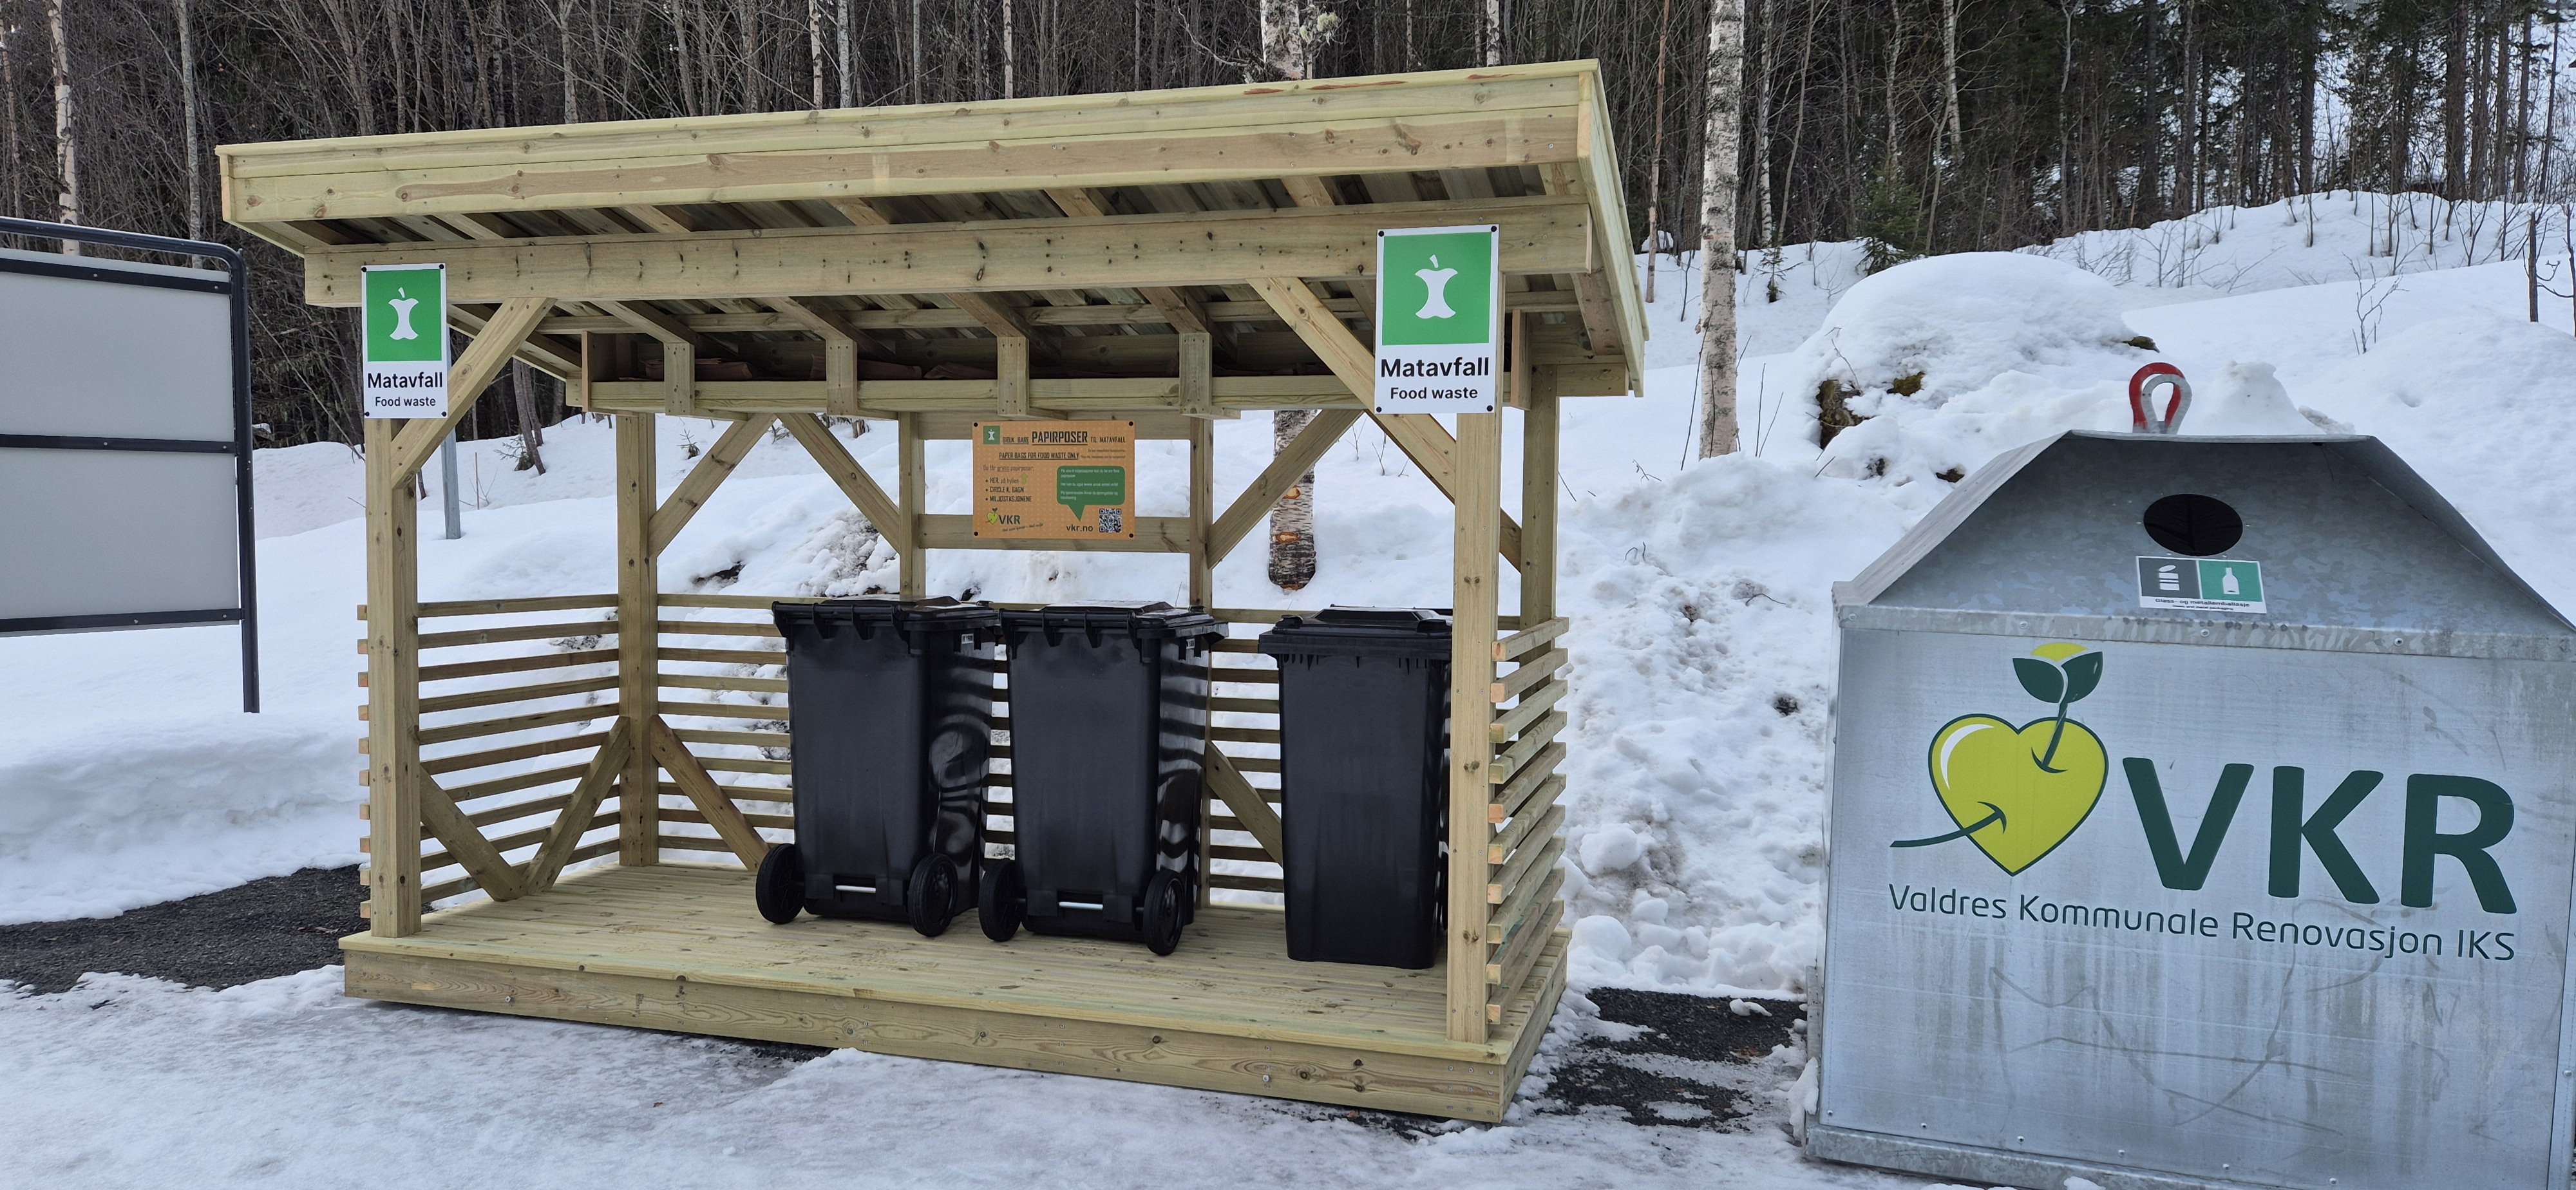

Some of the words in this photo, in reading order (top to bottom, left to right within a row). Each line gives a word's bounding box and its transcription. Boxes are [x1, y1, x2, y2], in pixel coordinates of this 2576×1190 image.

[1381, 357, 1490, 378] Matavfall
[367, 372, 443, 389] Matavfall
[1390, 387, 1428, 400] Food
[1432, 387, 1479, 399] waste
[375, 396, 401, 407] Food
[404, 397, 436, 407] waste
[1032, 431, 1088, 443] PAPIRPOSER
[999, 515, 1021, 525] VKR
[1066, 524, 1094, 532] vkr.no
[2123, 757, 2517, 914] VKR
[1888, 883, 2007, 919] Valdres
[2019, 894, 2219, 938] Kommunale
[2232, 912, 2442, 959] Renovasjon
[2458, 929, 2515, 961] IKS
